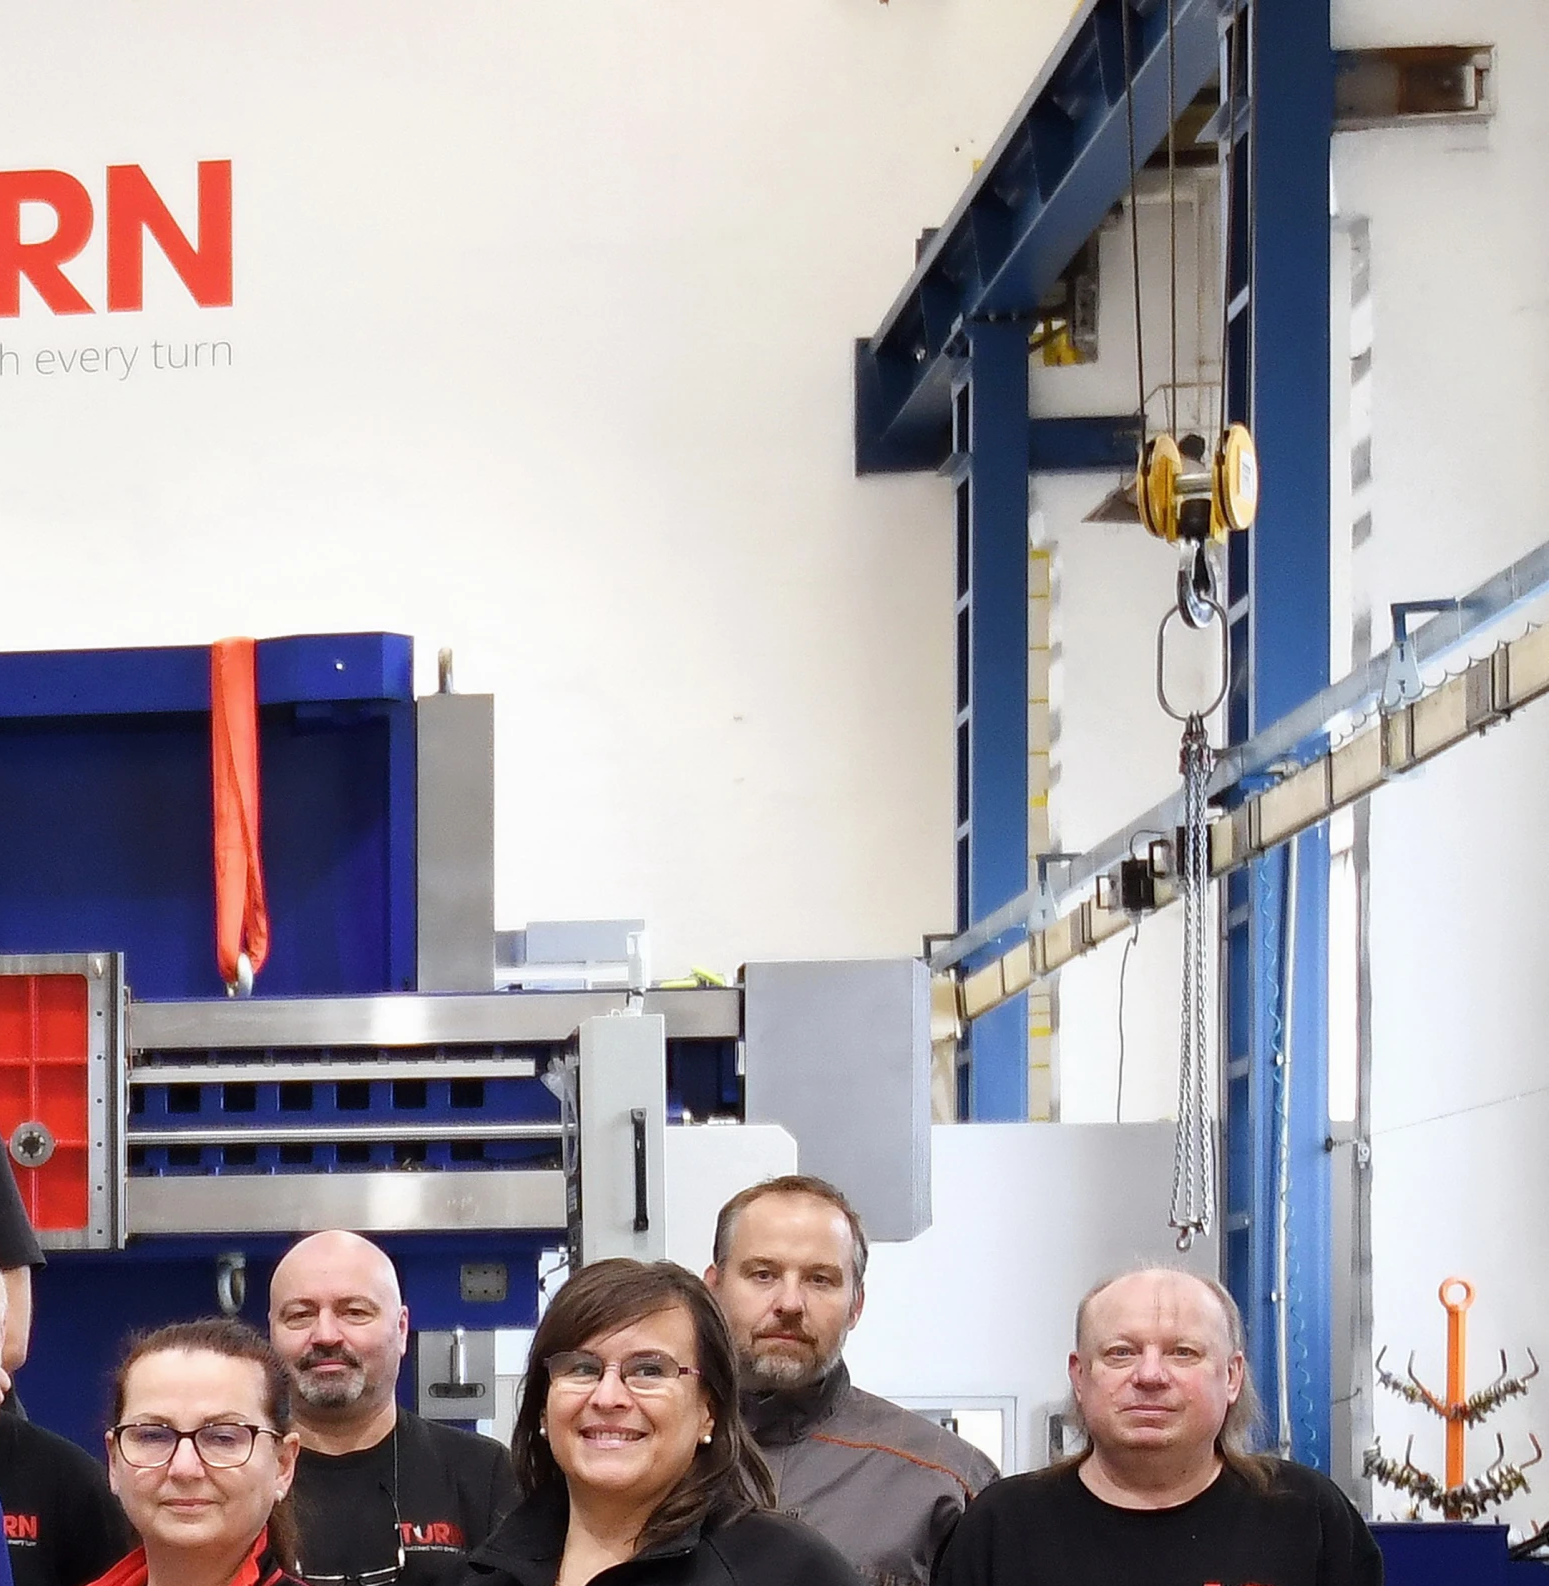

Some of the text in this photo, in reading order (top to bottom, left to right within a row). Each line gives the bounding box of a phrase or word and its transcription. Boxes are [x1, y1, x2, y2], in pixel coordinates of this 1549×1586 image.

[35, 344, 139, 382] every
[151, 338, 233, 371] turn
[3, 1515, 37, 1539] RN
